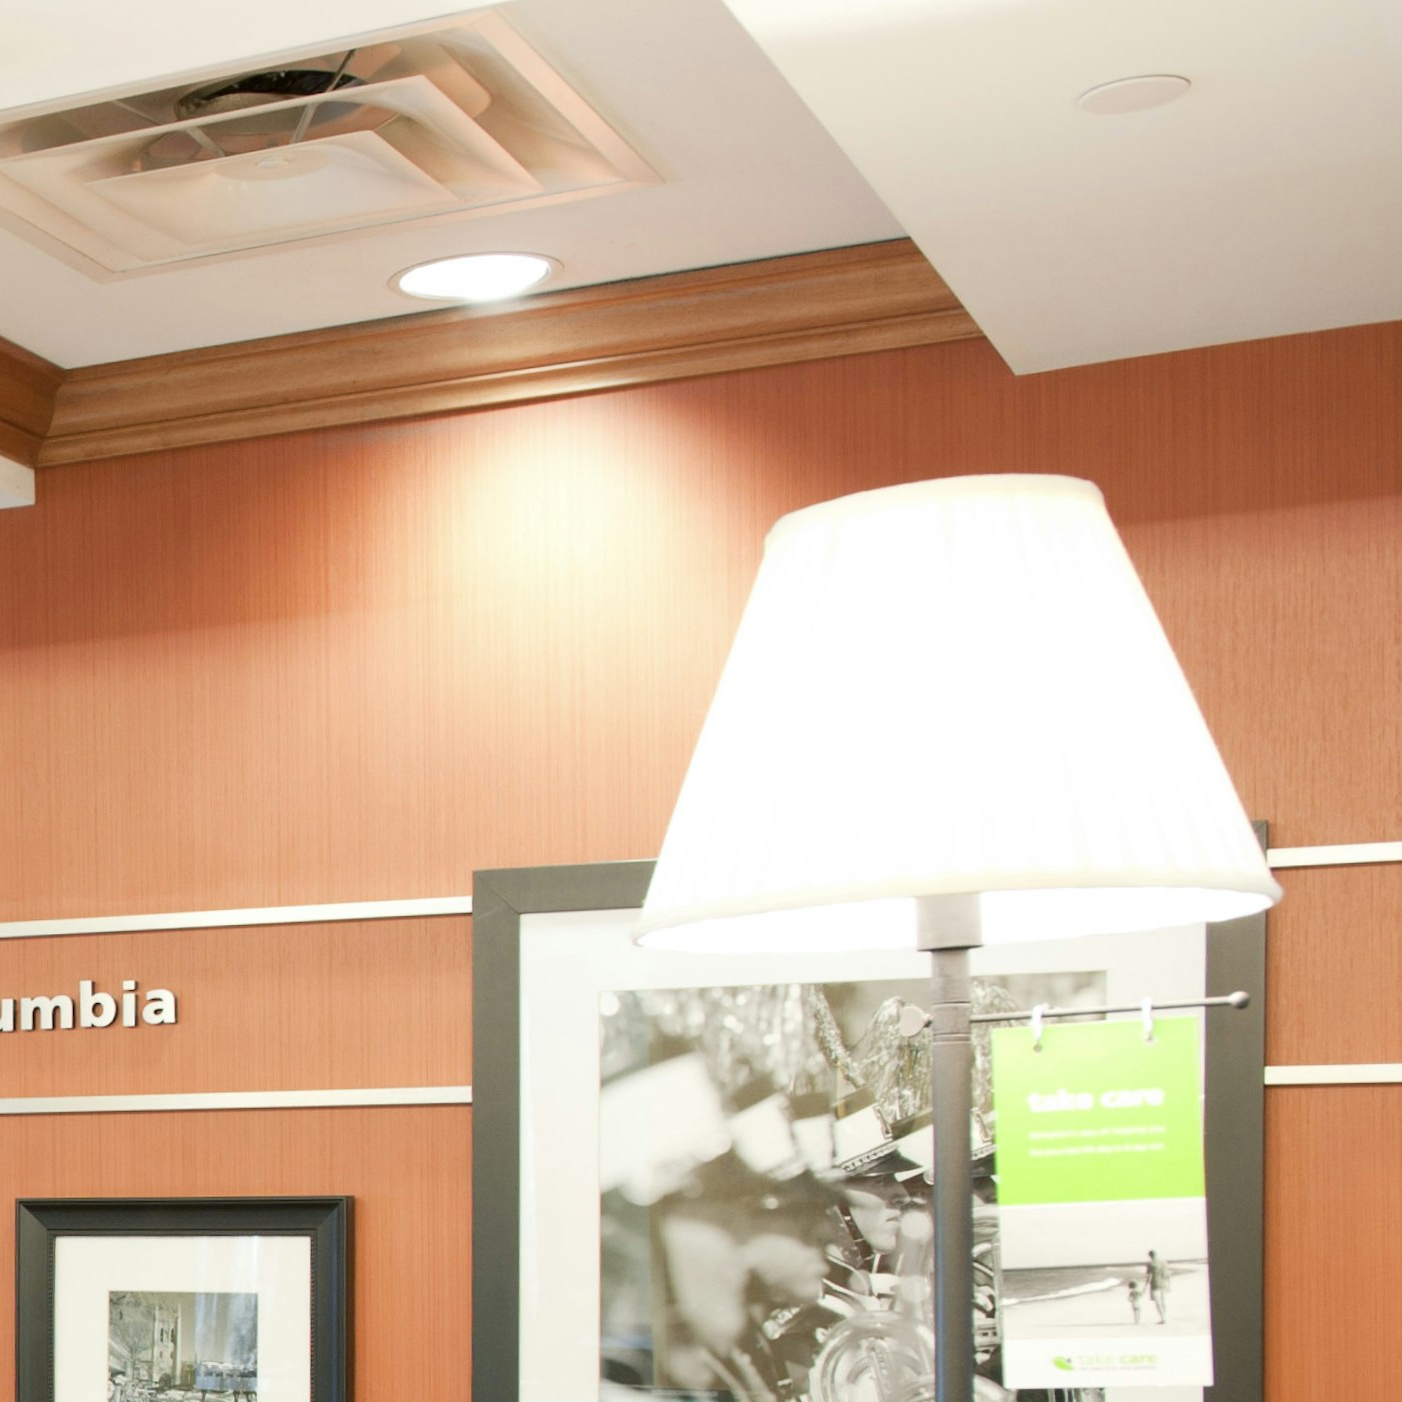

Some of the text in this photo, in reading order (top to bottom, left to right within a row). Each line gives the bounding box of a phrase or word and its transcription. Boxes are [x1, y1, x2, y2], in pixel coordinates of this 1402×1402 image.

[1028, 1088, 1164, 1112] take care
[1120, 1353, 1157, 1365] care
